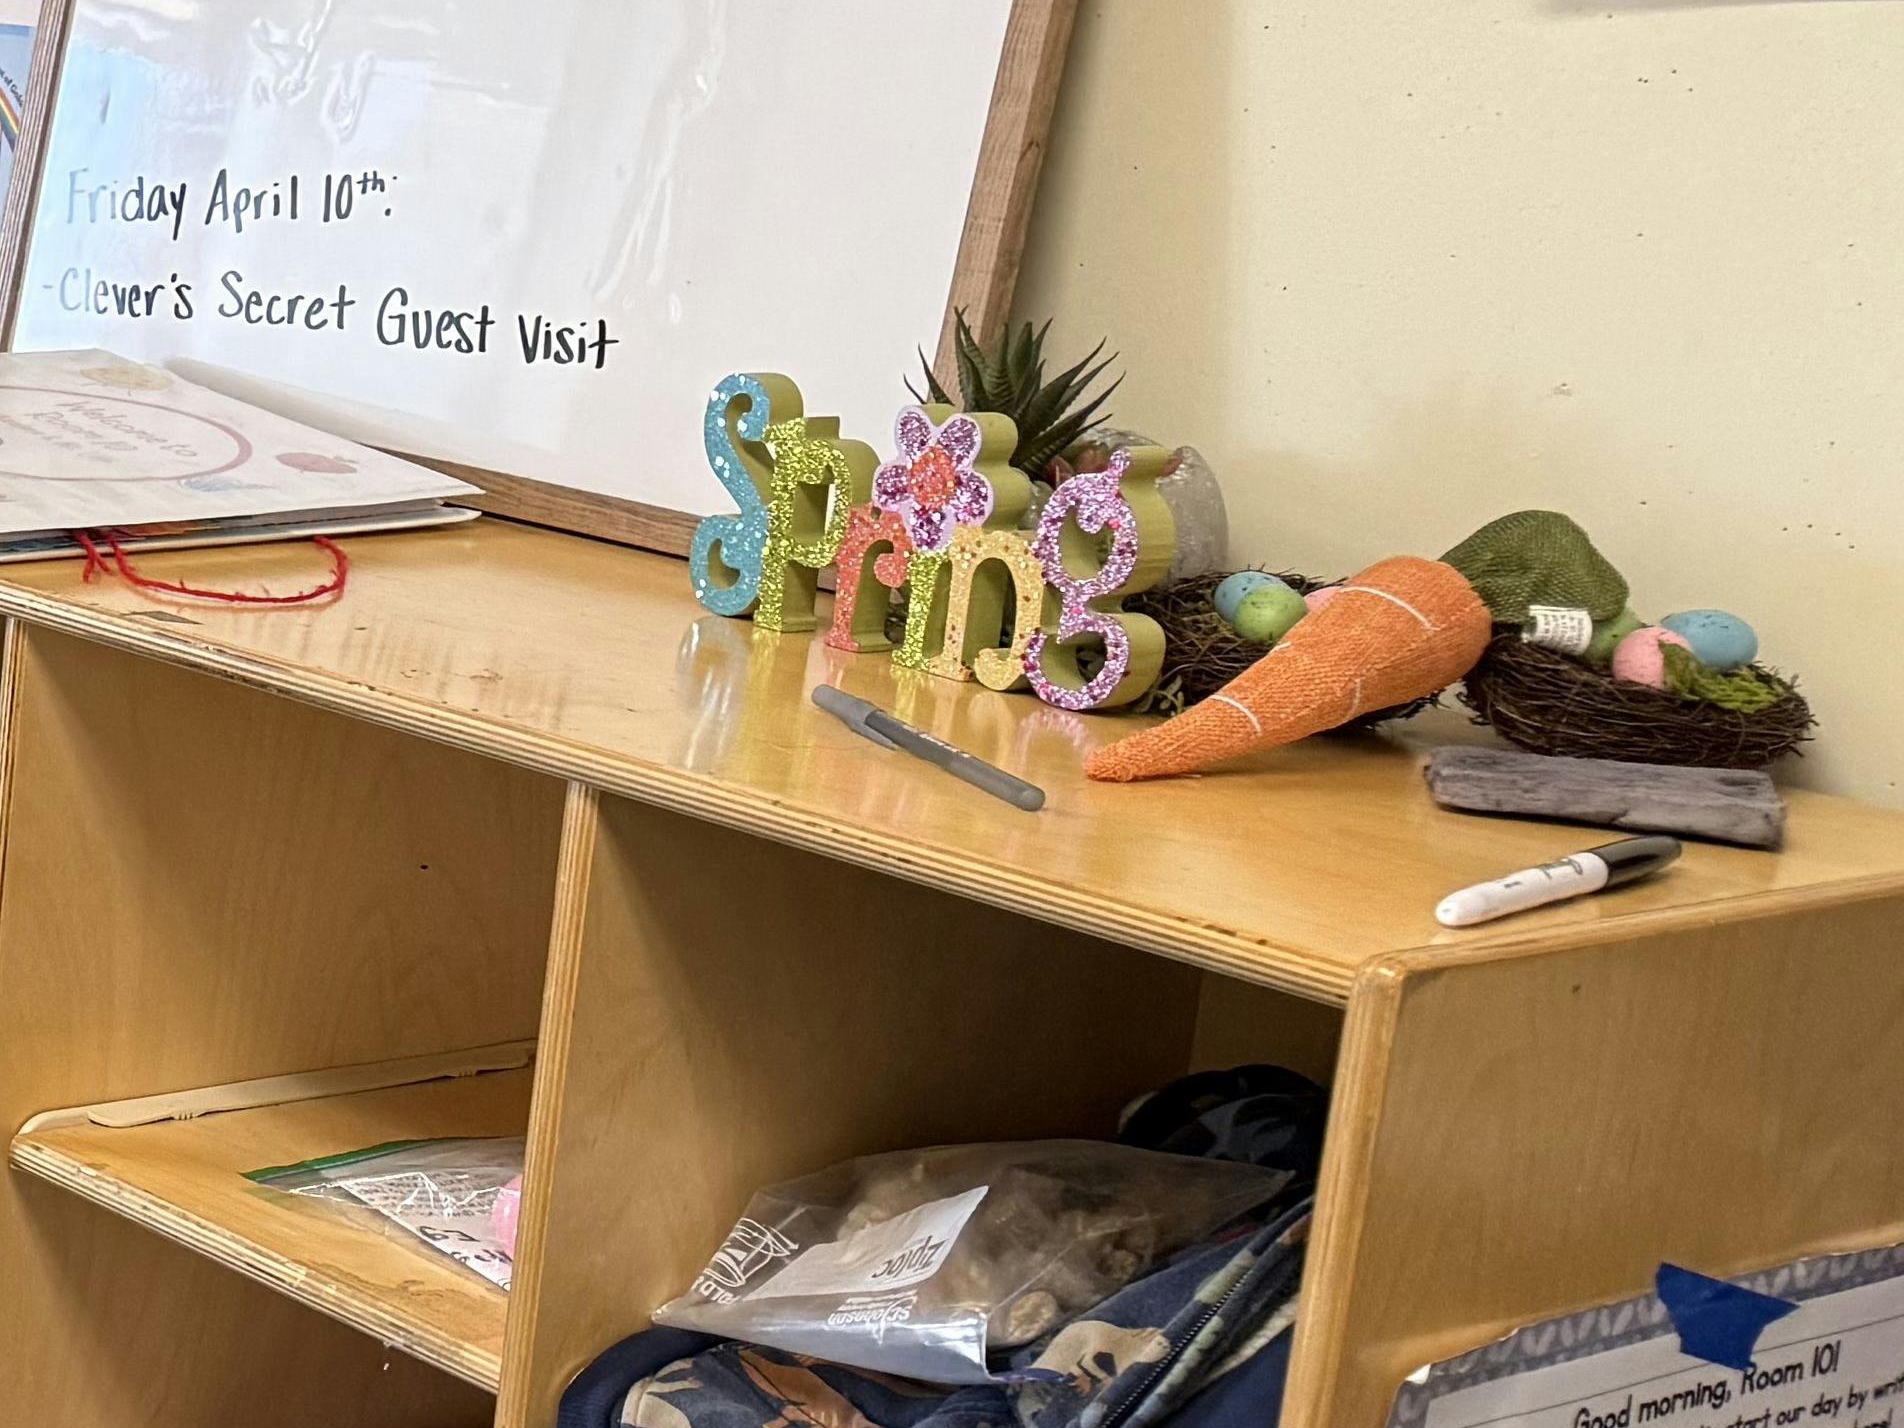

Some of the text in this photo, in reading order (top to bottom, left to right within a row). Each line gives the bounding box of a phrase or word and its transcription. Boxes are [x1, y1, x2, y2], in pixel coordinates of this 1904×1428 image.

[67, 168, 188, 241] Friday
[202, 168, 300, 239] April
[218, 269, 357, 332] Secret
[375, 286, 497, 356] Guest
[517, 314, 620, 370] Visit
[1638, 1378, 1733, 1424] morning,
[1740, 1363, 1805, 1397] Room
[1811, 1339, 1842, 1375] 10!
[1775, 1402, 1807, 1427] our
[1810, 1389, 1843, 1419] day
[1847, 1380, 1870, 1410] by
